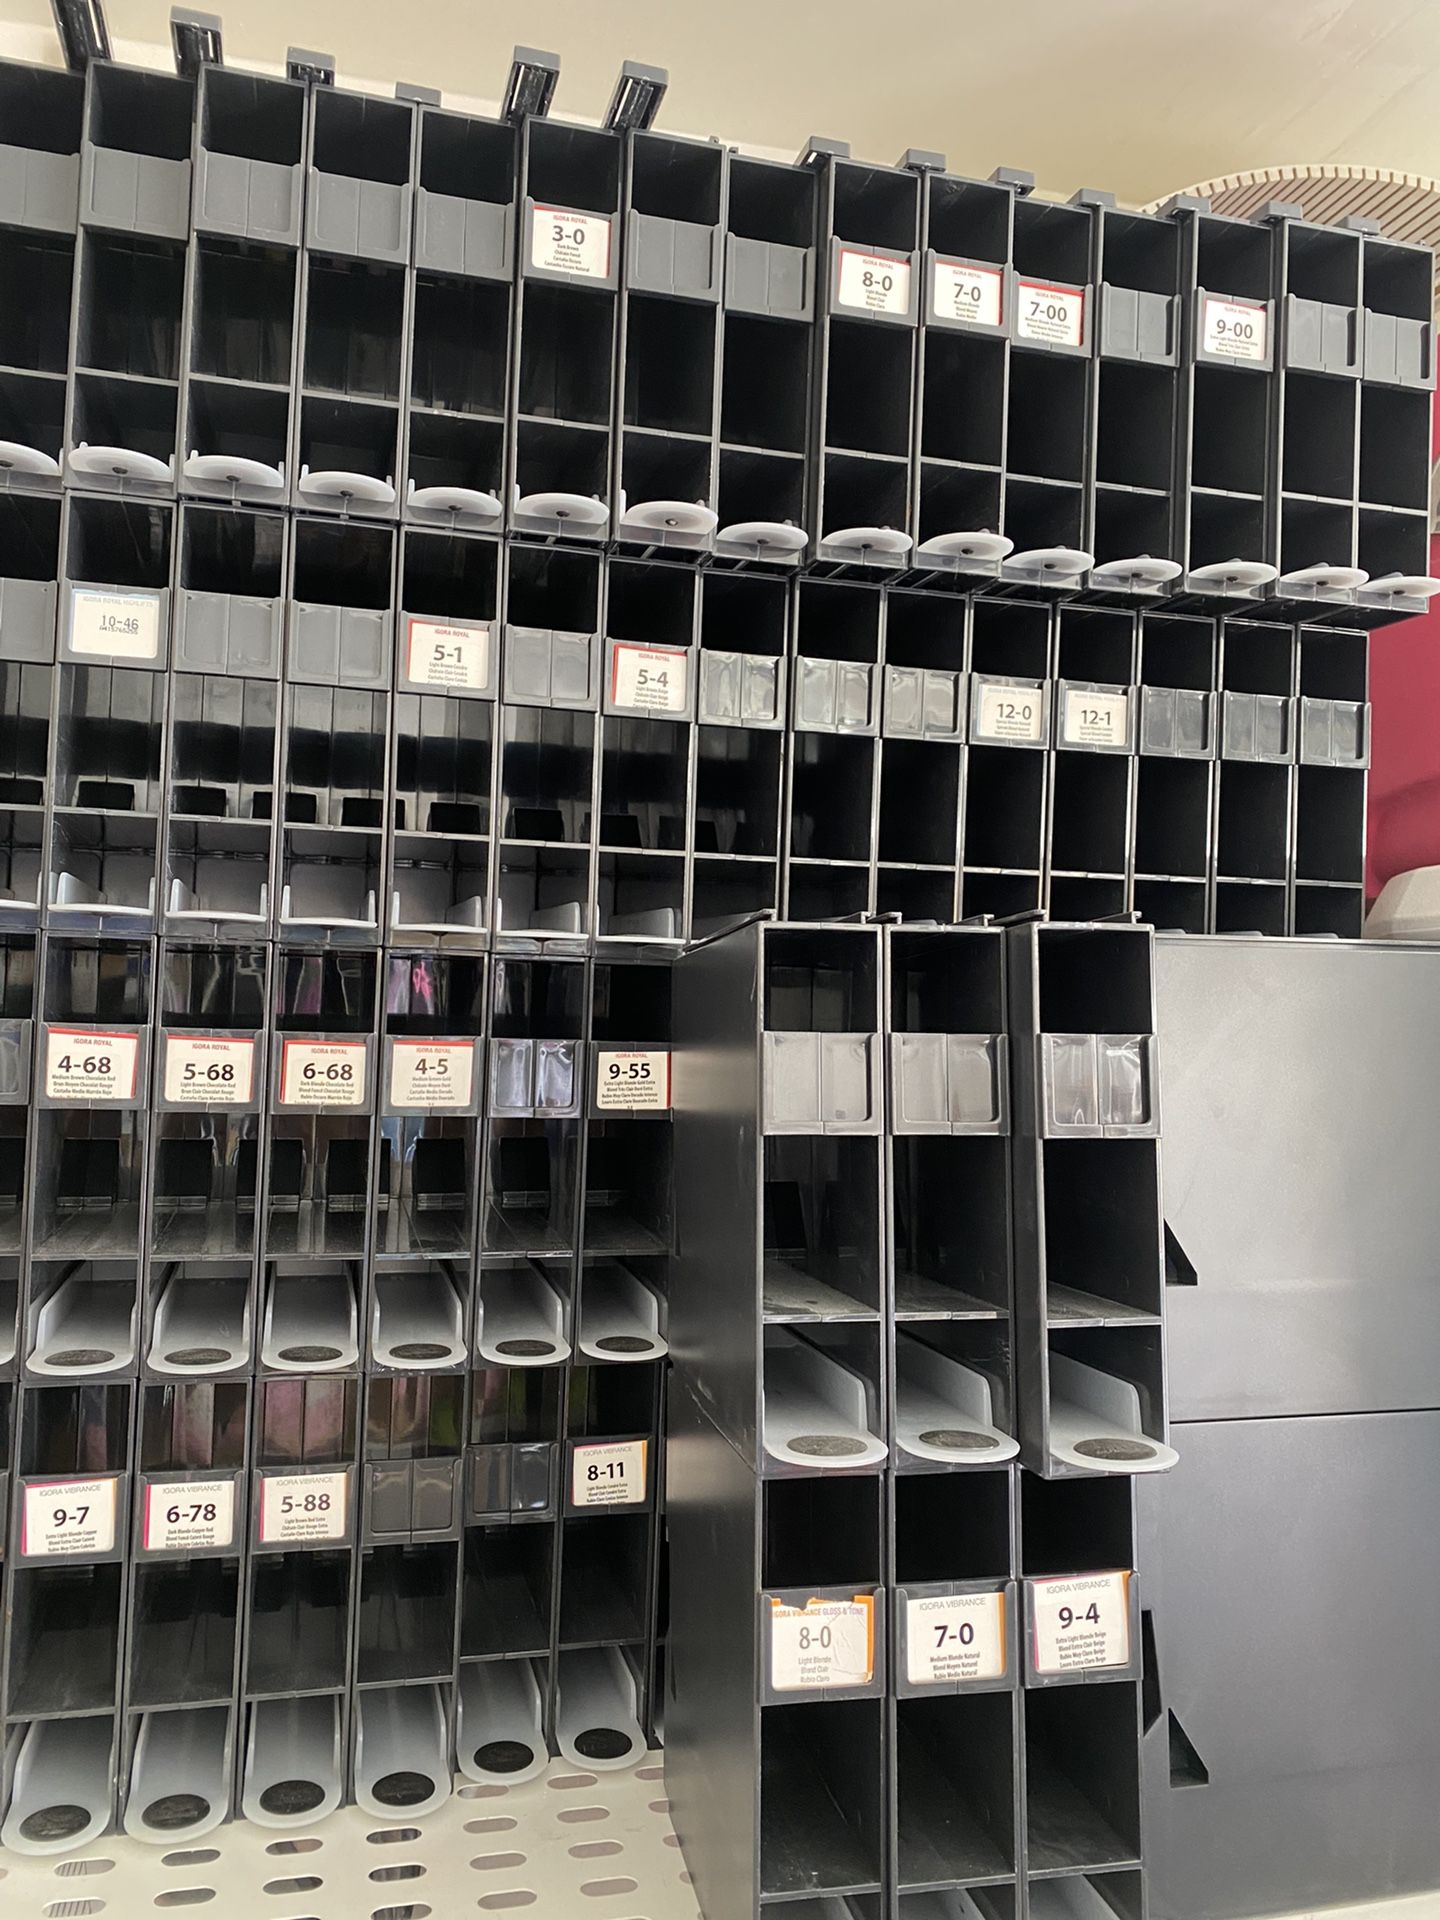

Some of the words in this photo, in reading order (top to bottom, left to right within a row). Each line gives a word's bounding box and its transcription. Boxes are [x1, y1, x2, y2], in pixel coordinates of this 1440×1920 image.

[552, 225, 585, 245] 3-0
[863, 272, 892, 291] 8-0
[954, 283, 981, 302] 7-0
[1031, 301, 1067, 322] 7-00
[1217, 319, 1253, 339] 9-00
[103, 615, 139, 630] 10-46
[433, 644, 462, 662] 5-1
[637, 669, 668, 687] 5-4
[997, 704, 1032, 720] 12-0
[1081, 710, 1110, 725] 12-1
[58, 1055, 111, 1074] 4-68
[184, 1063, 234, 1081] 5-68
[303, 1063, 352, 1080] 6-68
[415, 1059, 448, 1075] 4-5
[609, 1063, 650, 1079] 9-55
[300, 1476, 334, 1484] VIBRANCE
[588, 1462, 623, 1481] 8-11
[40, 1488, 63, 1496] IGORA
[64, 1484, 101, 1494] VIBRANCE
[281, 1494, 330, 1513] 5-88
[53, 1507, 89, 1527] 9-7
[167, 1504, 216, 1523] 6-78
[1047, 1585, 1071, 1594] IGORA
[1072, 1580, 1111, 1590] VIBRANCE
[920, 1601, 944, 1610] IGORA
[946, 1598, 985, 1608] VIBRANCE
[1059, 1602, 1100, 1629] 9-4
[800, 1626, 831, 1649] 8-0
[934, 1623, 974, 1647] 7-0
